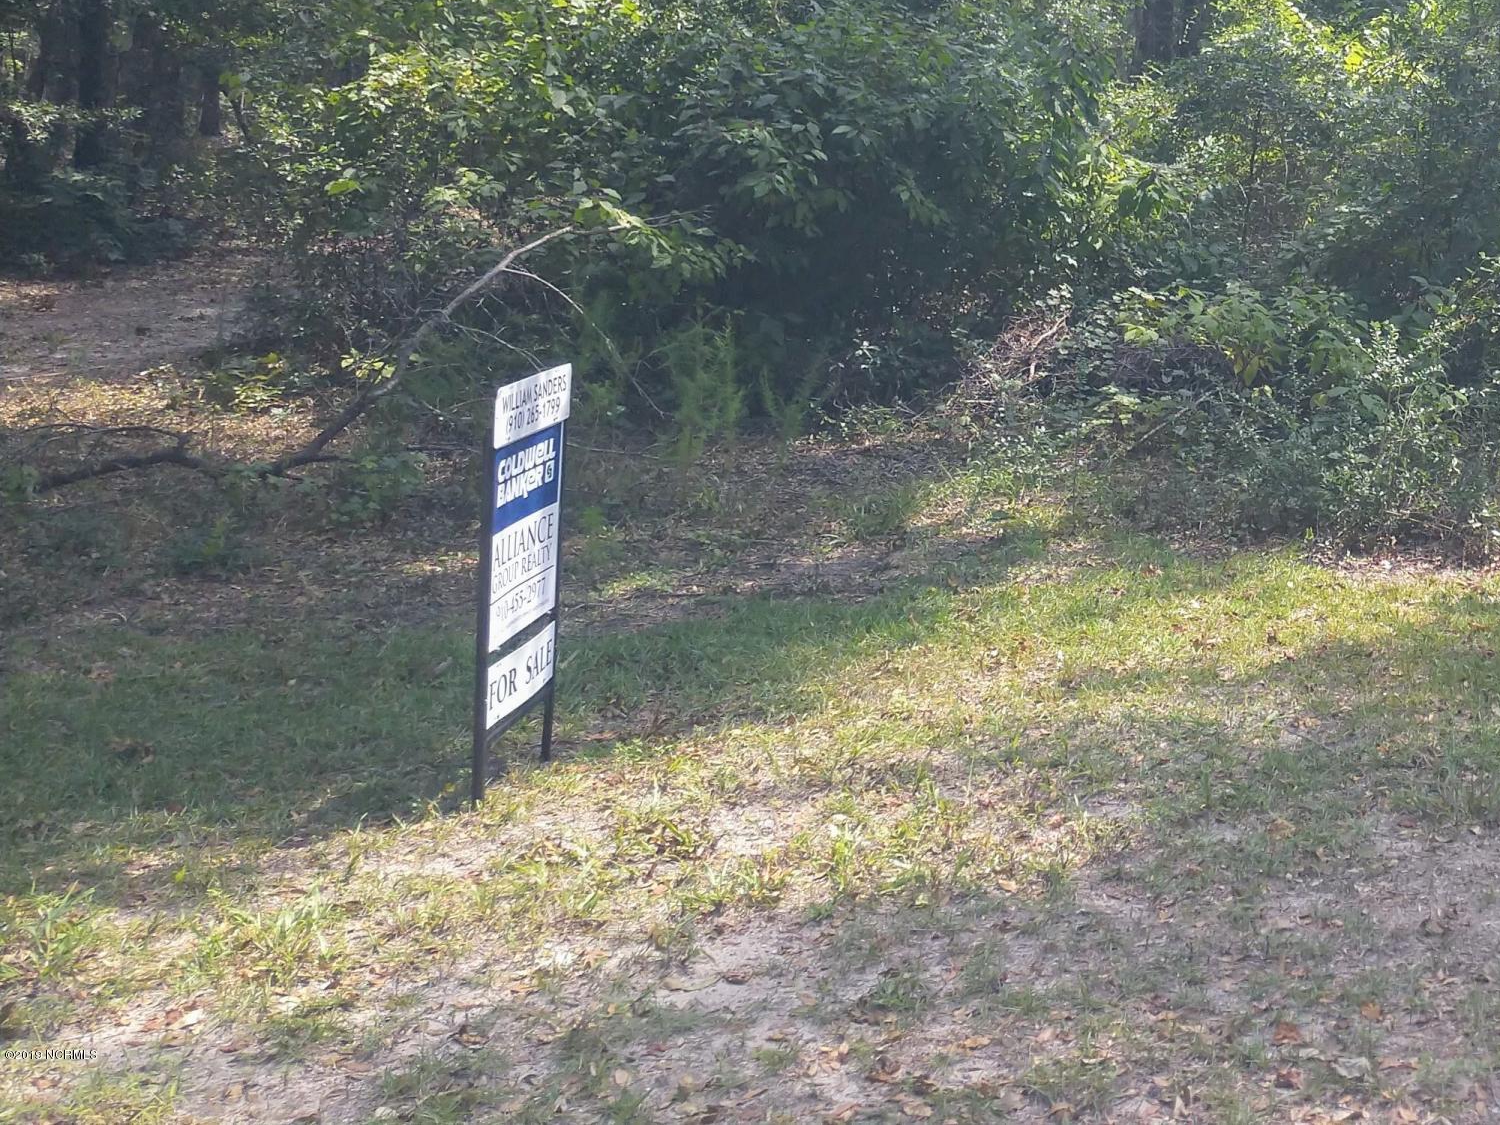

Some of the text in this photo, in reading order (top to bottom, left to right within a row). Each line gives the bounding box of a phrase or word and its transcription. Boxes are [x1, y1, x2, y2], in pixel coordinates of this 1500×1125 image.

[502, 375, 567, 414] WILLIAM SANDERS
[506, 397, 561, 433] (910) 265-1799
[493, 513, 554, 571] ALLIANCE
[492, 544, 552, 594] GROUP REALTY
[489, 638, 553, 711] FOR SALE
